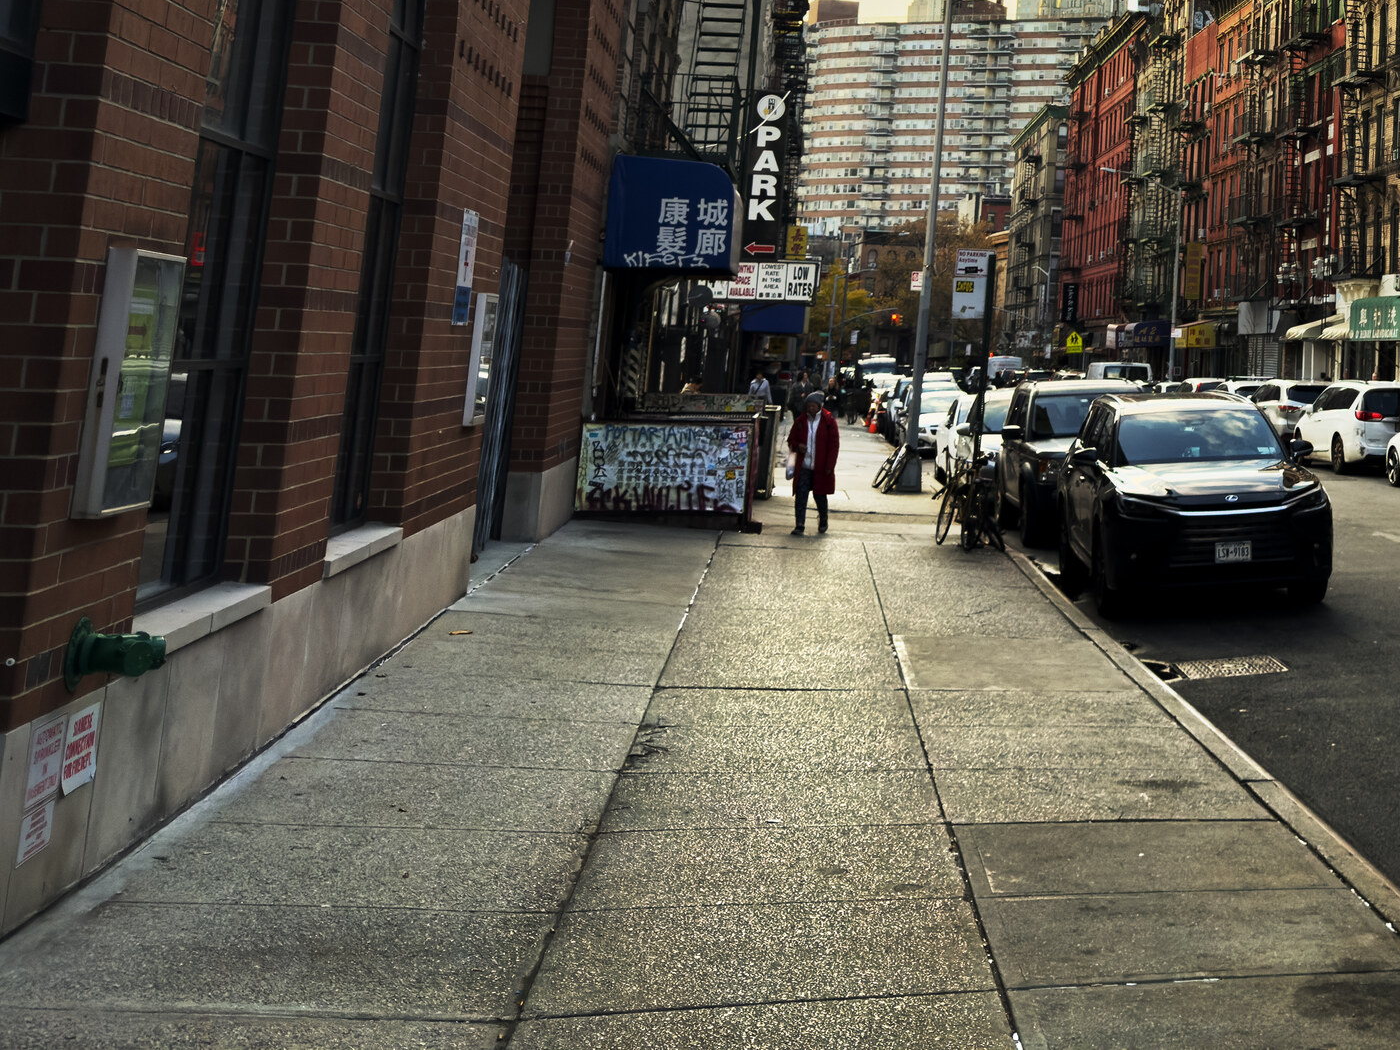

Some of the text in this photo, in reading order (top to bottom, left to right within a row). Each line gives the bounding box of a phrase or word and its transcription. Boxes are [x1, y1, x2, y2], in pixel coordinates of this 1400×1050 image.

[748, 126, 782, 221] PARK
[658, 197, 728, 226] 康城
[793, 266, 809, 281] LOW
[729, 287, 755, 297] AVAILABLE
[788, 282, 812, 296] RATES
